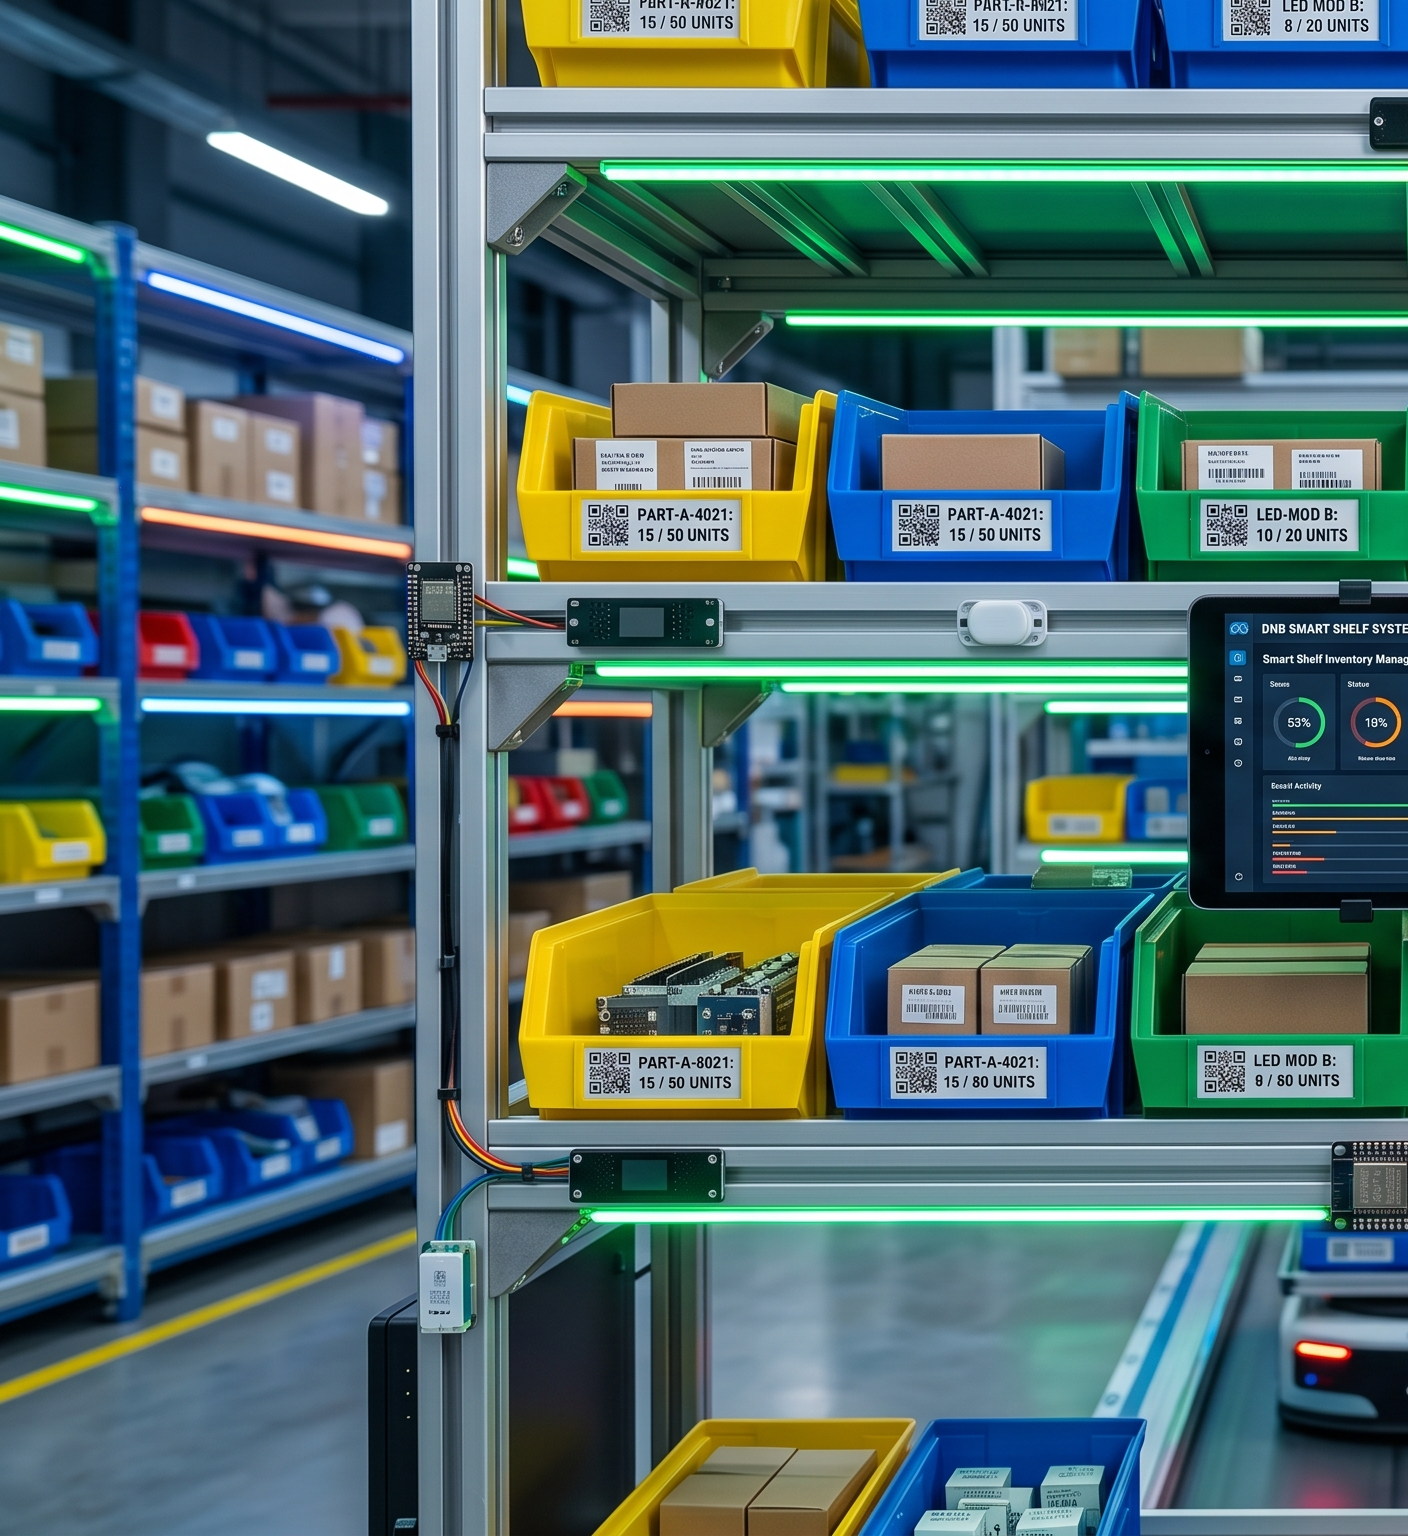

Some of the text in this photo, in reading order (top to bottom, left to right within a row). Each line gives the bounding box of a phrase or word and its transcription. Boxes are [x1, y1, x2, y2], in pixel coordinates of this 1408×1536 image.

[1282, 0, 1364, 13] LED MOD B:
[639, 15, 734, 30] 15 / 50 UNITS
[972, 18, 1065, 33] 15 / 50 UNITS
[1284, 18, 1369, 33] 8 / 20 UNITS
[637, 507, 733, 522] PART-A-4021:
[948, 507, 1044, 521] PART-A-4021:
[1256, 507, 1338, 522] LED-MOD B:
[637, 527, 730, 543] 15 / 50 UNITS
[949, 527, 1041, 543] 15 / 50 UNITS
[1256, 528, 1348, 543] 10 / 20 UNITS
[1261, 622, 1287, 636] DNB
[1288, 622, 1331, 636] SMART
[1332, 622, 1370, 636] SHELF
[1262, 653, 1295, 664] Smart
[1296, 653, 1323, 664] Shelf
[1325, 654, 1374, 667] Inventory
[1287, 717, 1312, 728] 53%
[1294, 782, 1322, 791] Activity
[638, 1055, 734, 1070] PART-A-8021:
[944, 1055, 1039, 1069] PART-A-4021:
[1254, 1053, 1336, 1067] LED MOD B:
[639, 1075, 732, 1090] 15 / 50 UNITS
[943, 1075, 1035, 1089] 15 / 80 UNITS
[1267, 1074, 1273, 1087] /
[1298, 1073, 1340, 1087] UNITS
